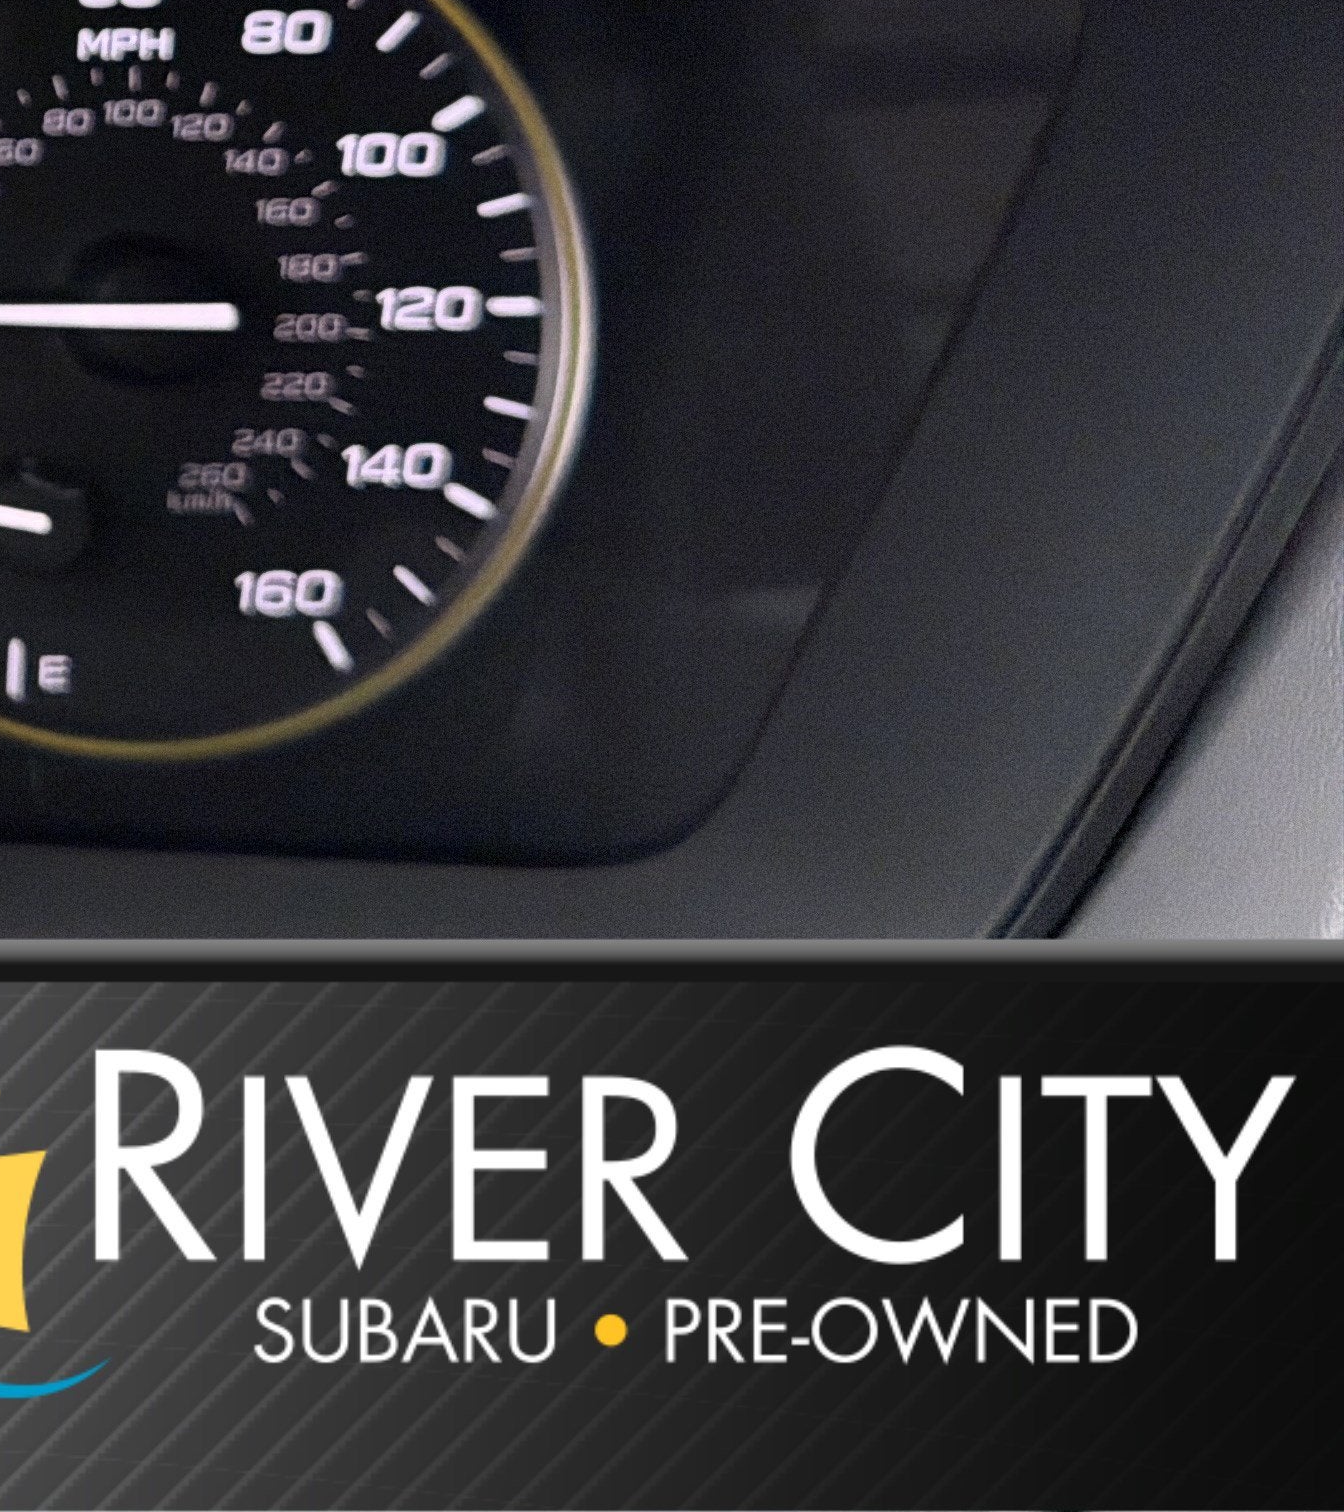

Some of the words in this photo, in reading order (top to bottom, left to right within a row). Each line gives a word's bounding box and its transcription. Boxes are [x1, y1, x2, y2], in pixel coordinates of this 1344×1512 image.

[76, 27, 176, 61] MPH
[240, 9, 333, 55] 80
[42, 108, 94, 136] 80
[103, 98, 166, 127] 100
[171, 112, 233, 141] 120
[224, 147, 288, 176] 140
[336, 132, 447, 178] 100
[256, 197, 313, 226] 160
[278, 254, 335, 283] 180
[375, 285, 483, 332] 120
[273, 313, 343, 342] 200
[261, 371, 331, 401] 220
[231, 427, 305, 457] 240
[341, 442, 451, 489] 140
[234, 569, 344, 618] 160
[38, 654, 73, 693] E
